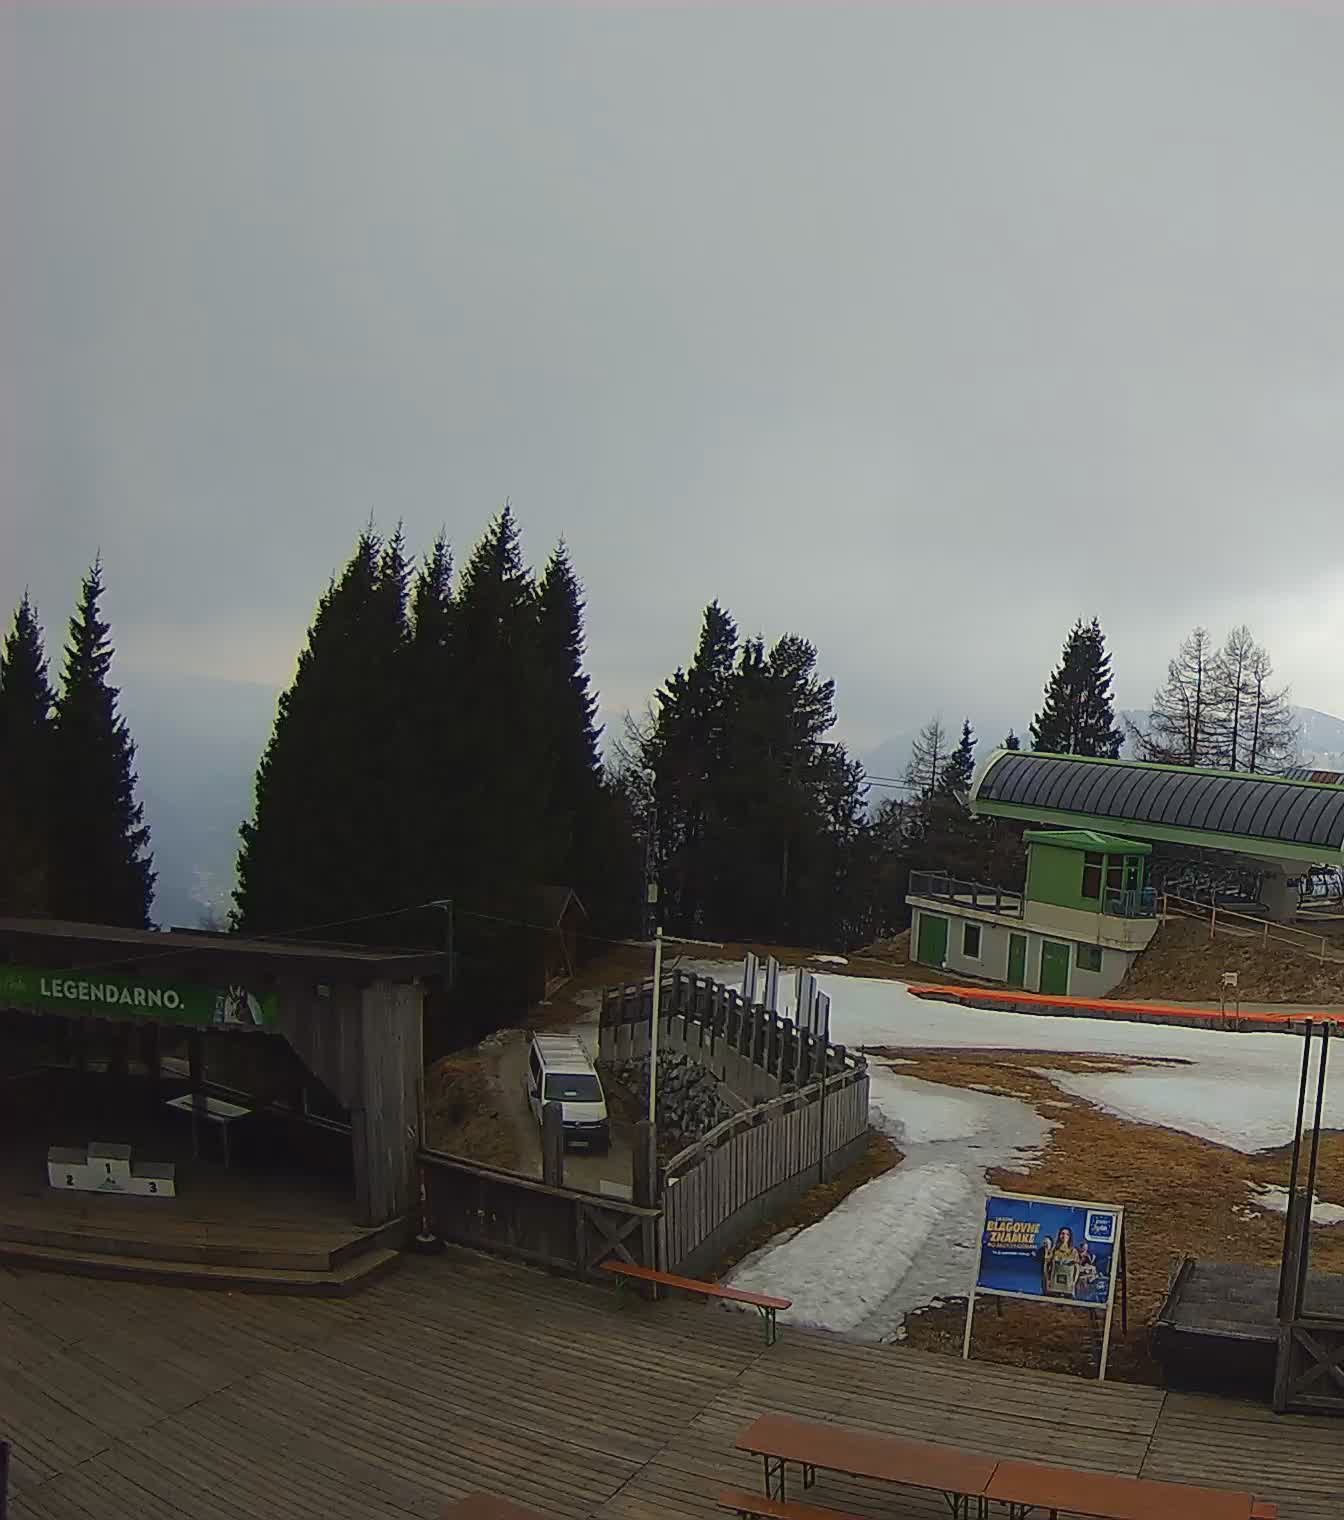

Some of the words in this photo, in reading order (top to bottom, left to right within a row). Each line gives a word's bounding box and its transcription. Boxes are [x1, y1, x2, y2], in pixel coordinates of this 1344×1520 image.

[40, 977, 185, 1009] LEGENDARNO.
[105, 1162, 111, 1174] 1
[66, 1174, 74, 1186] 2
[149, 1182, 157, 1193] 3
[990, 1232, 1035, 1244] ZNAMKE
